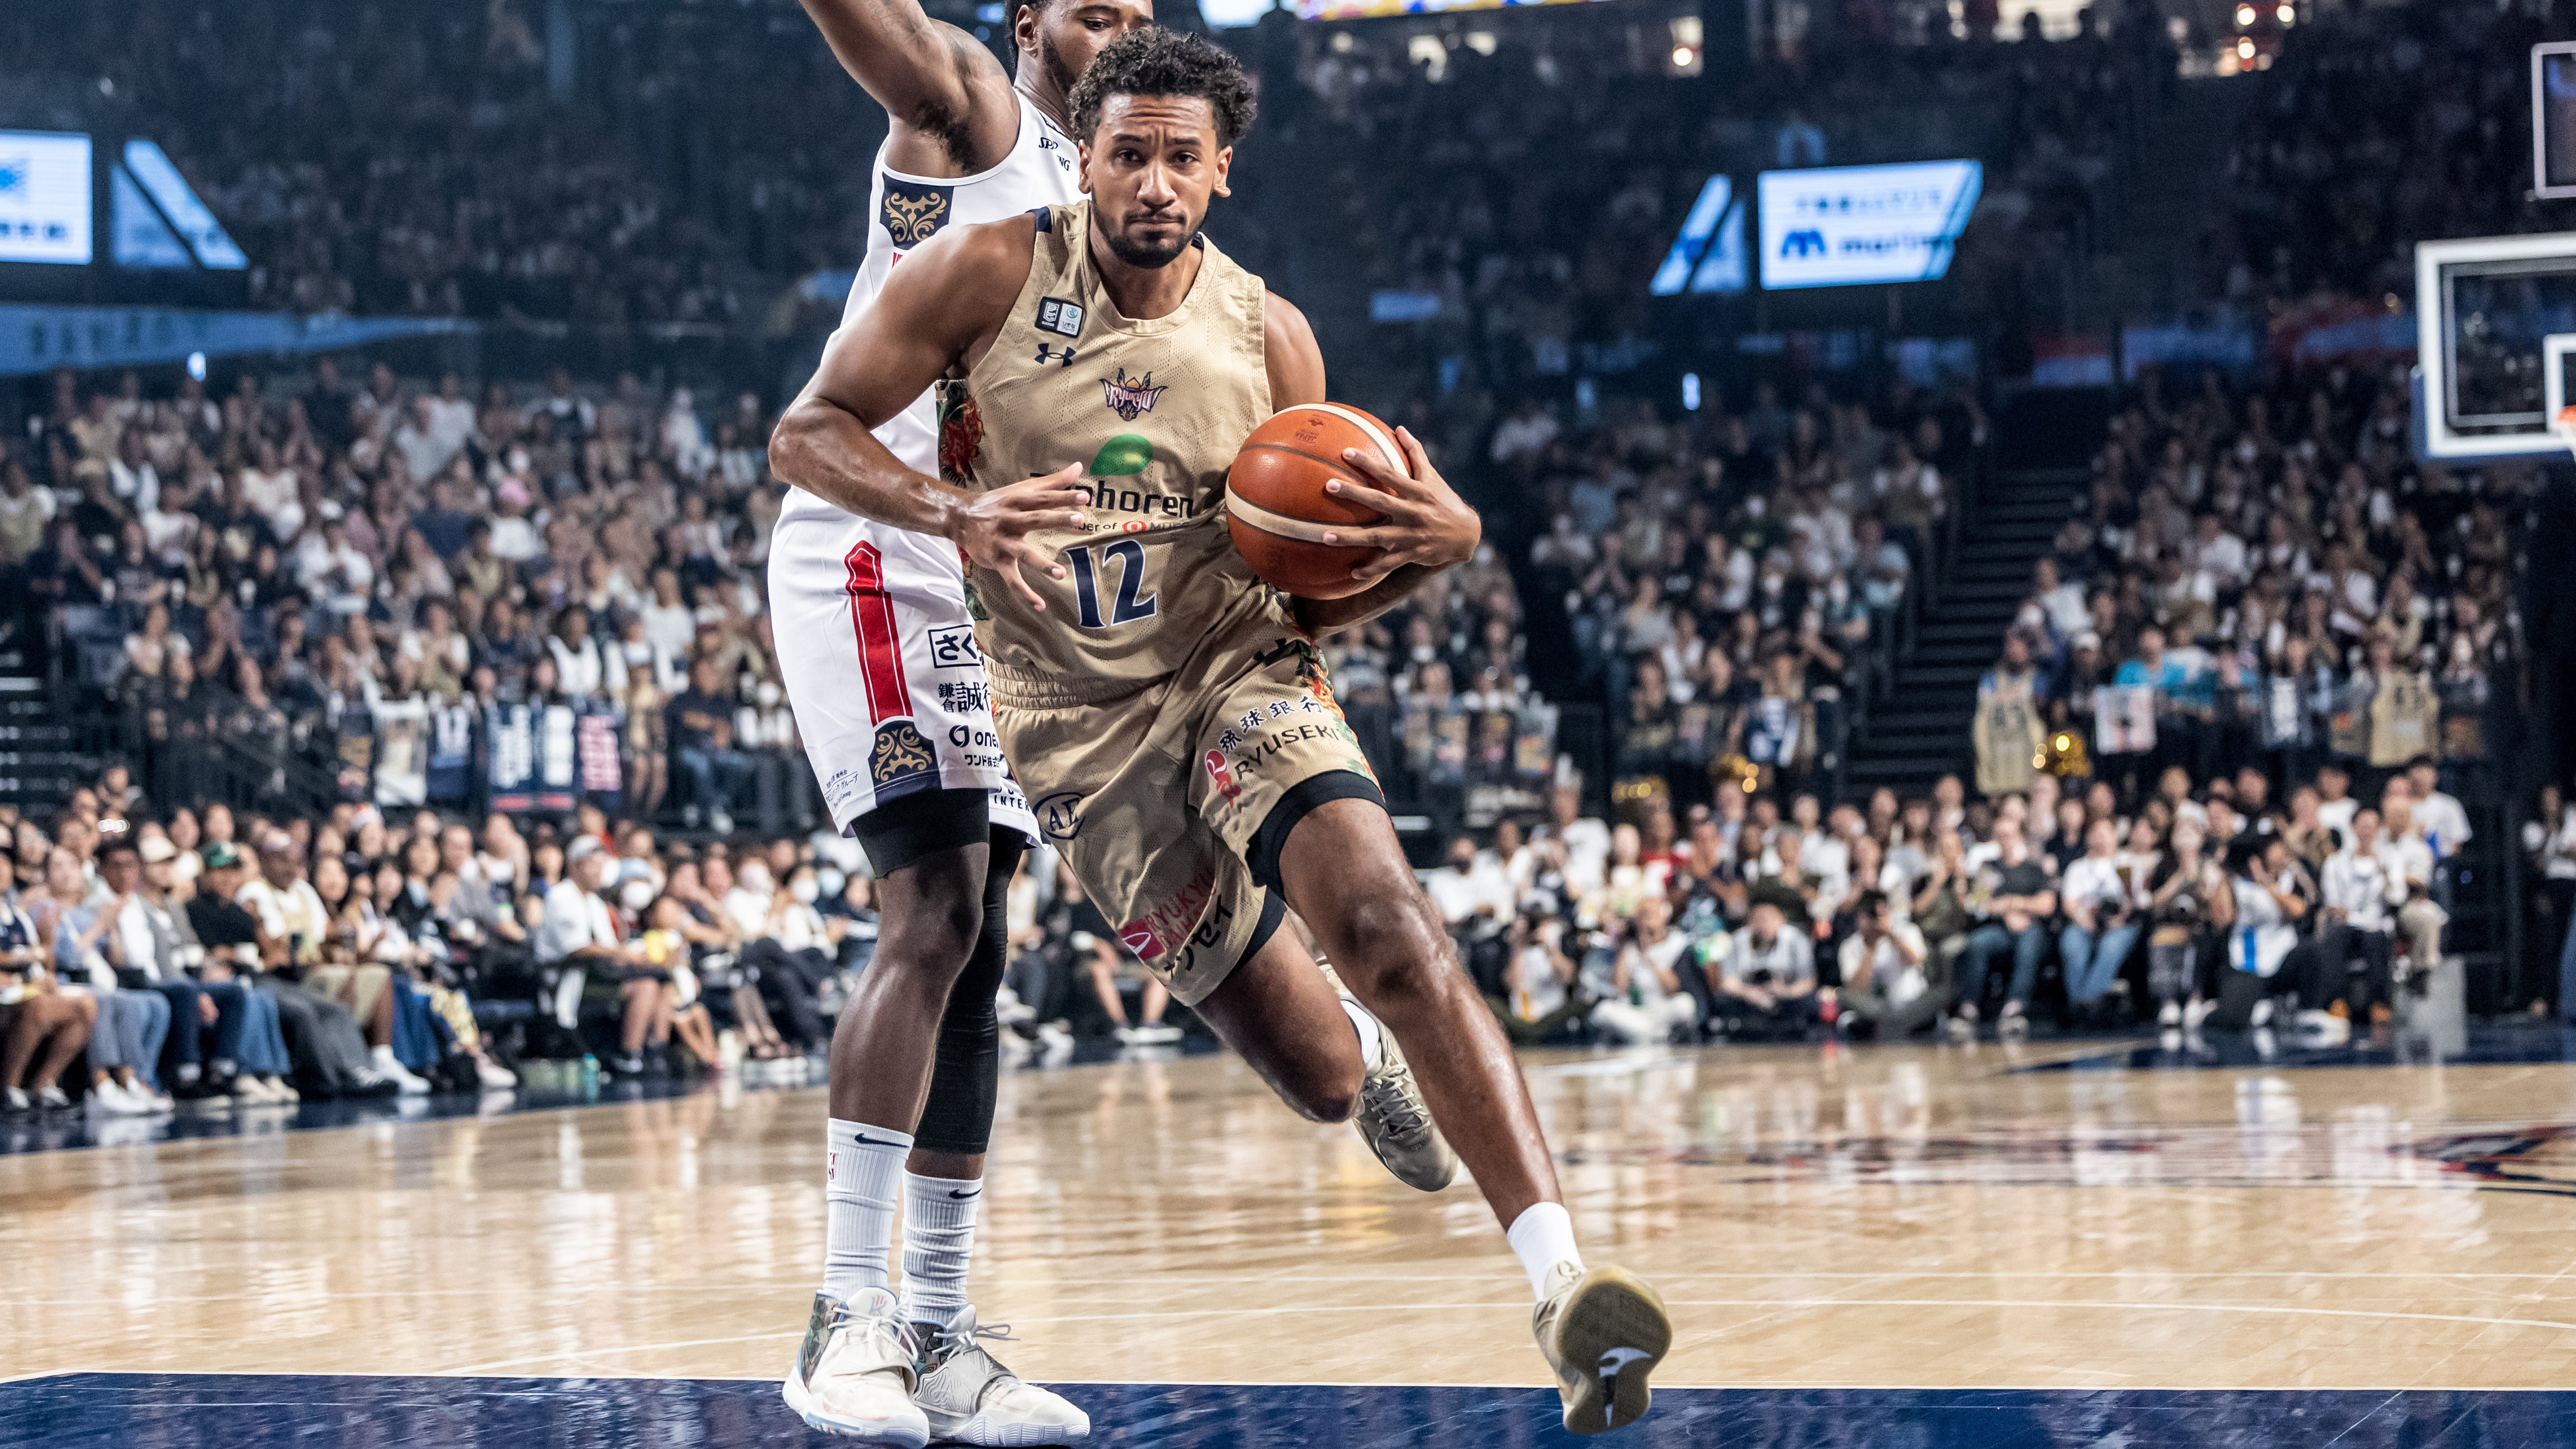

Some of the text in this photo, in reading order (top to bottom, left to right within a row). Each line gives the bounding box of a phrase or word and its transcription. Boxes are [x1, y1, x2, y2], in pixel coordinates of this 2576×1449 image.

[1107, 384, 1156, 412] RYUKYU
[1064, 539, 1157, 629] 12
[1221, 696, 1322, 753] 琉球銀行
[1235, 725, 1338, 780] RYUSEKI
